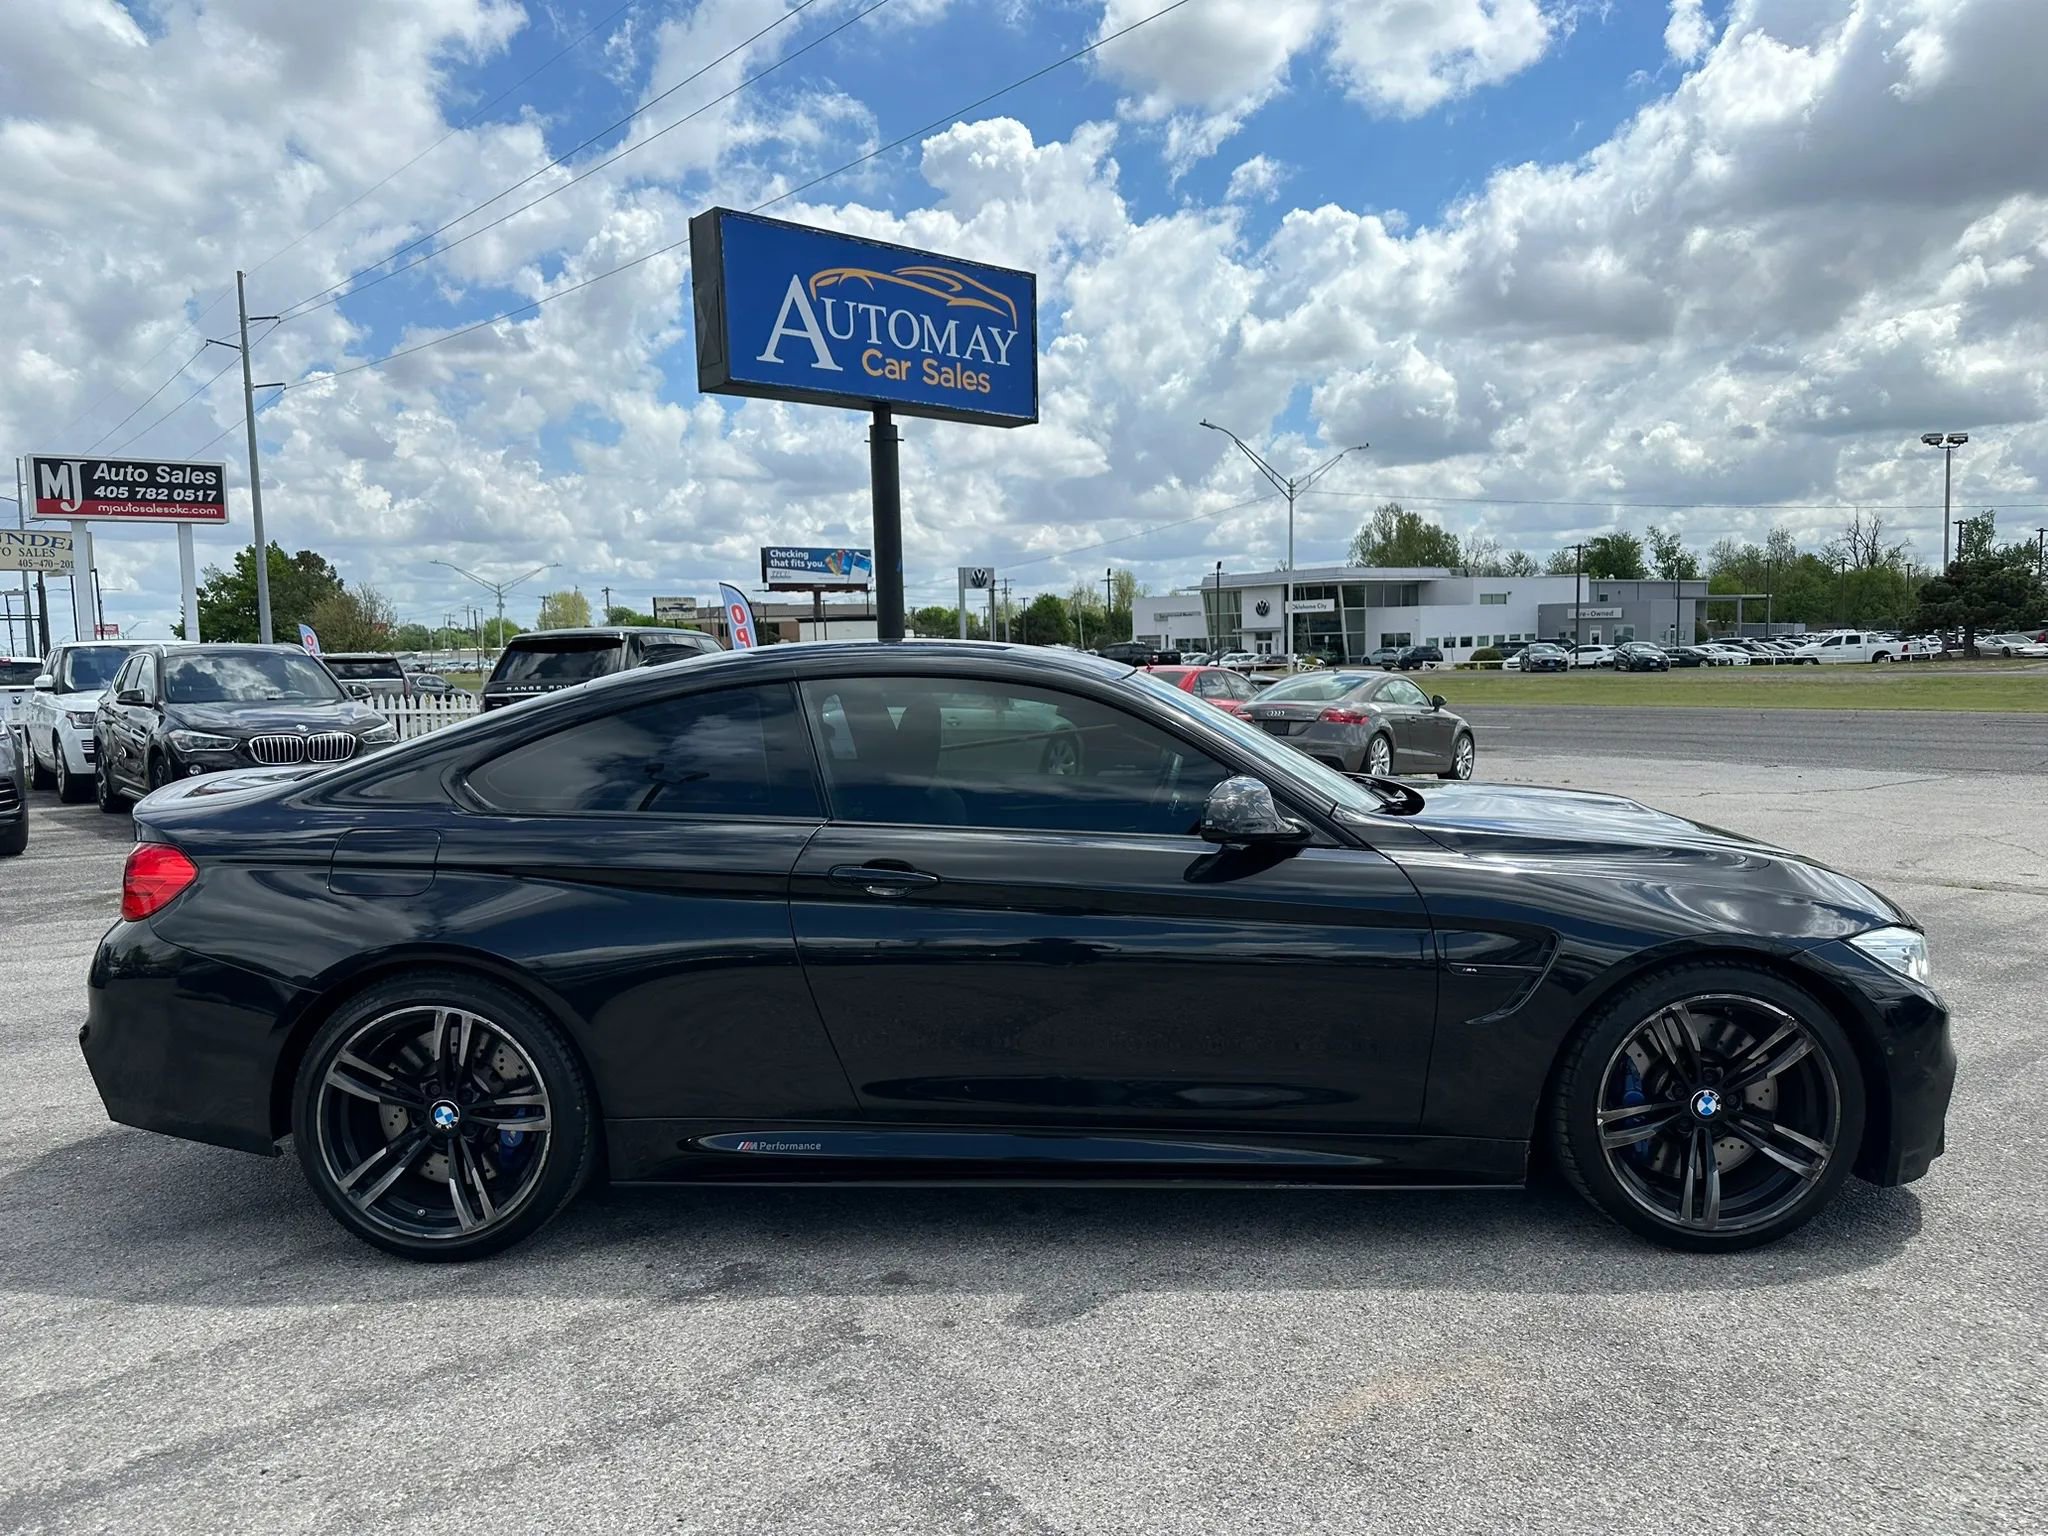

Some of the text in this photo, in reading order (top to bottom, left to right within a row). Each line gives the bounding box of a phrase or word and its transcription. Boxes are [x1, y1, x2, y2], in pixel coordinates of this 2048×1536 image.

[756, 273, 1018, 371] AUTOMAY
[861, 348, 991, 394] Car Sales
[93, 463, 217, 485] Auto Sales
[40, 461, 87, 512] MJ
[94, 485, 217, 502] 405 782 0517
[98, 502, 217, 515] mjautosalesokc.com
[18, 547, 56, 558] SALES
[769, 549, 809, 560] Checking
[770, 559, 825, 569] that fits you.
[759, 1141, 822, 1151] Performance
